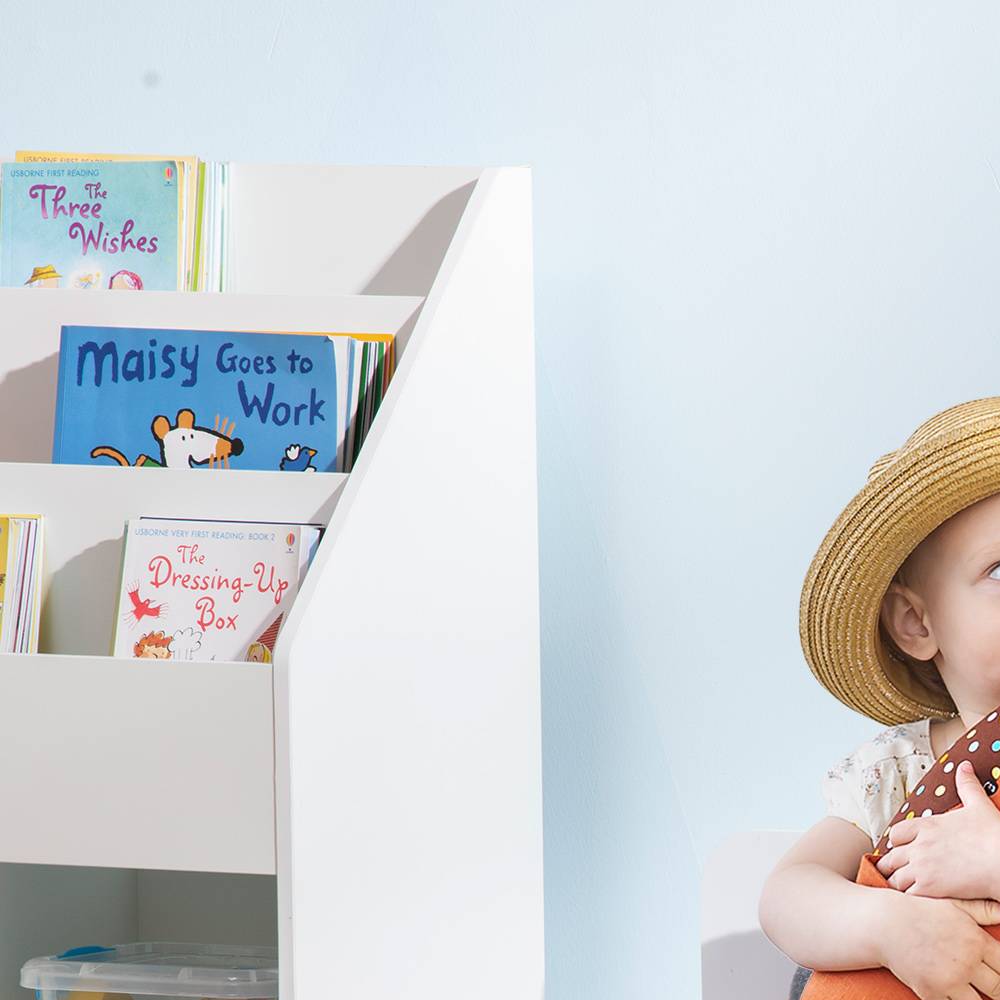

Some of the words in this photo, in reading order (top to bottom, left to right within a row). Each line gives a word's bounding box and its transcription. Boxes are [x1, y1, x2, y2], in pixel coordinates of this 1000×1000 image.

[10, 169, 45, 177] USBORNE
[46, 169, 65, 177] FIRST
[67, 169, 100, 177] READING
[29, 183, 102, 219] Three
[84, 182, 108, 200] The
[68, 219, 158, 256] Wishes
[216, 342, 276, 375] Goes
[287, 349, 313, 374] to
[237, 380, 326, 426] Work
[135, 528, 169, 537] USBORNE
[171, 529, 188, 538] VERY
[191, 530, 209, 538] FIRST
[248, 532, 269, 541] BOOK
[270, 533, 276, 541] 2
[176, 544, 206, 565] The
[148, 555, 289, 605] Dressing-Up
[195, 596, 239, 632] Box
